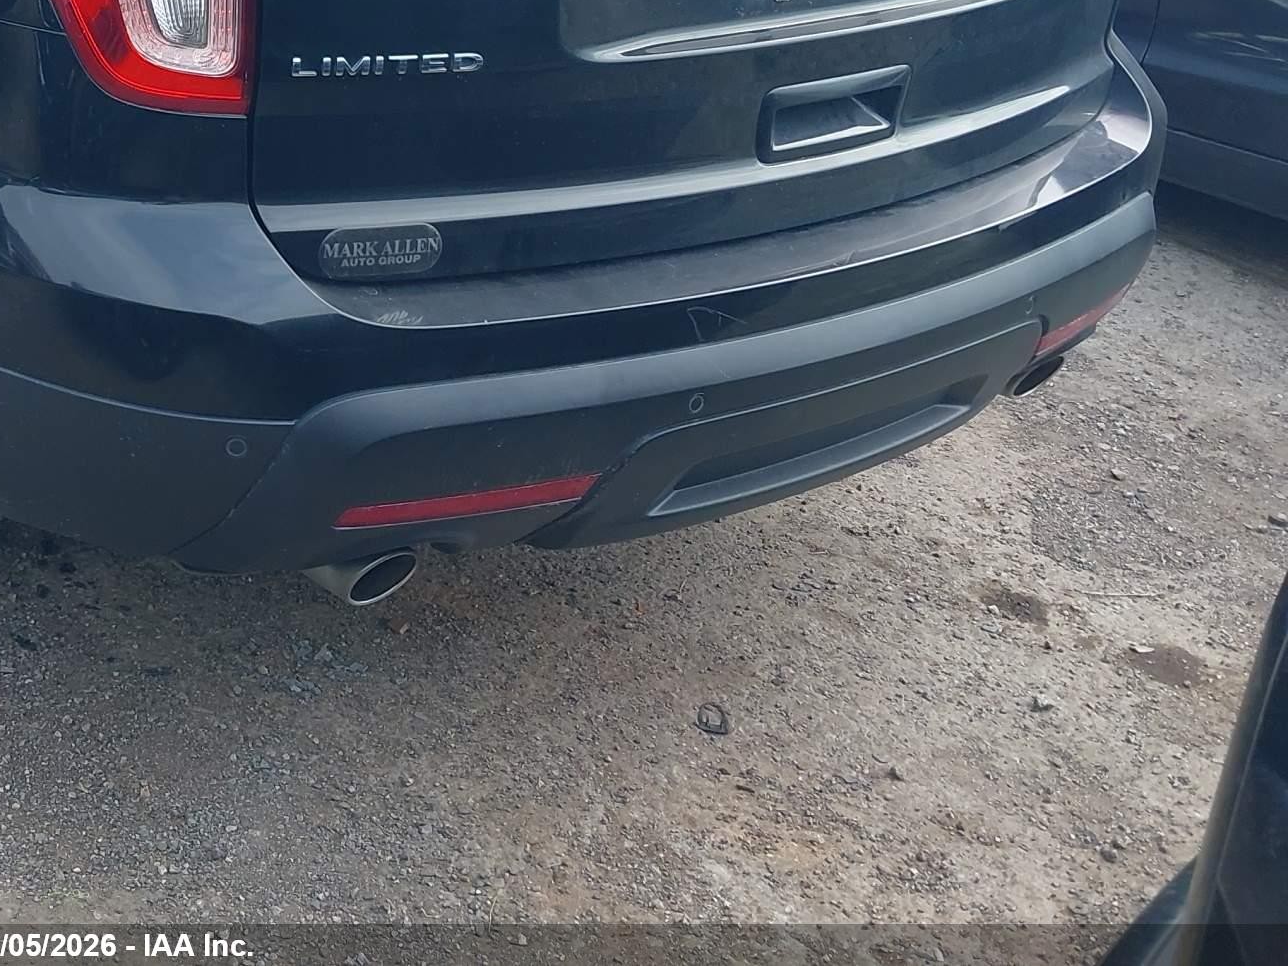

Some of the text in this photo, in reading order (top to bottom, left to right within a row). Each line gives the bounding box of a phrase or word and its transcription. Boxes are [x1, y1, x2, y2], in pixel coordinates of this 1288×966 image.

[291, 52, 484, 77] LIMITED
[323, 237, 440, 259] MARK ALLEN
[341, 254, 421, 267] AUTO GROUP
